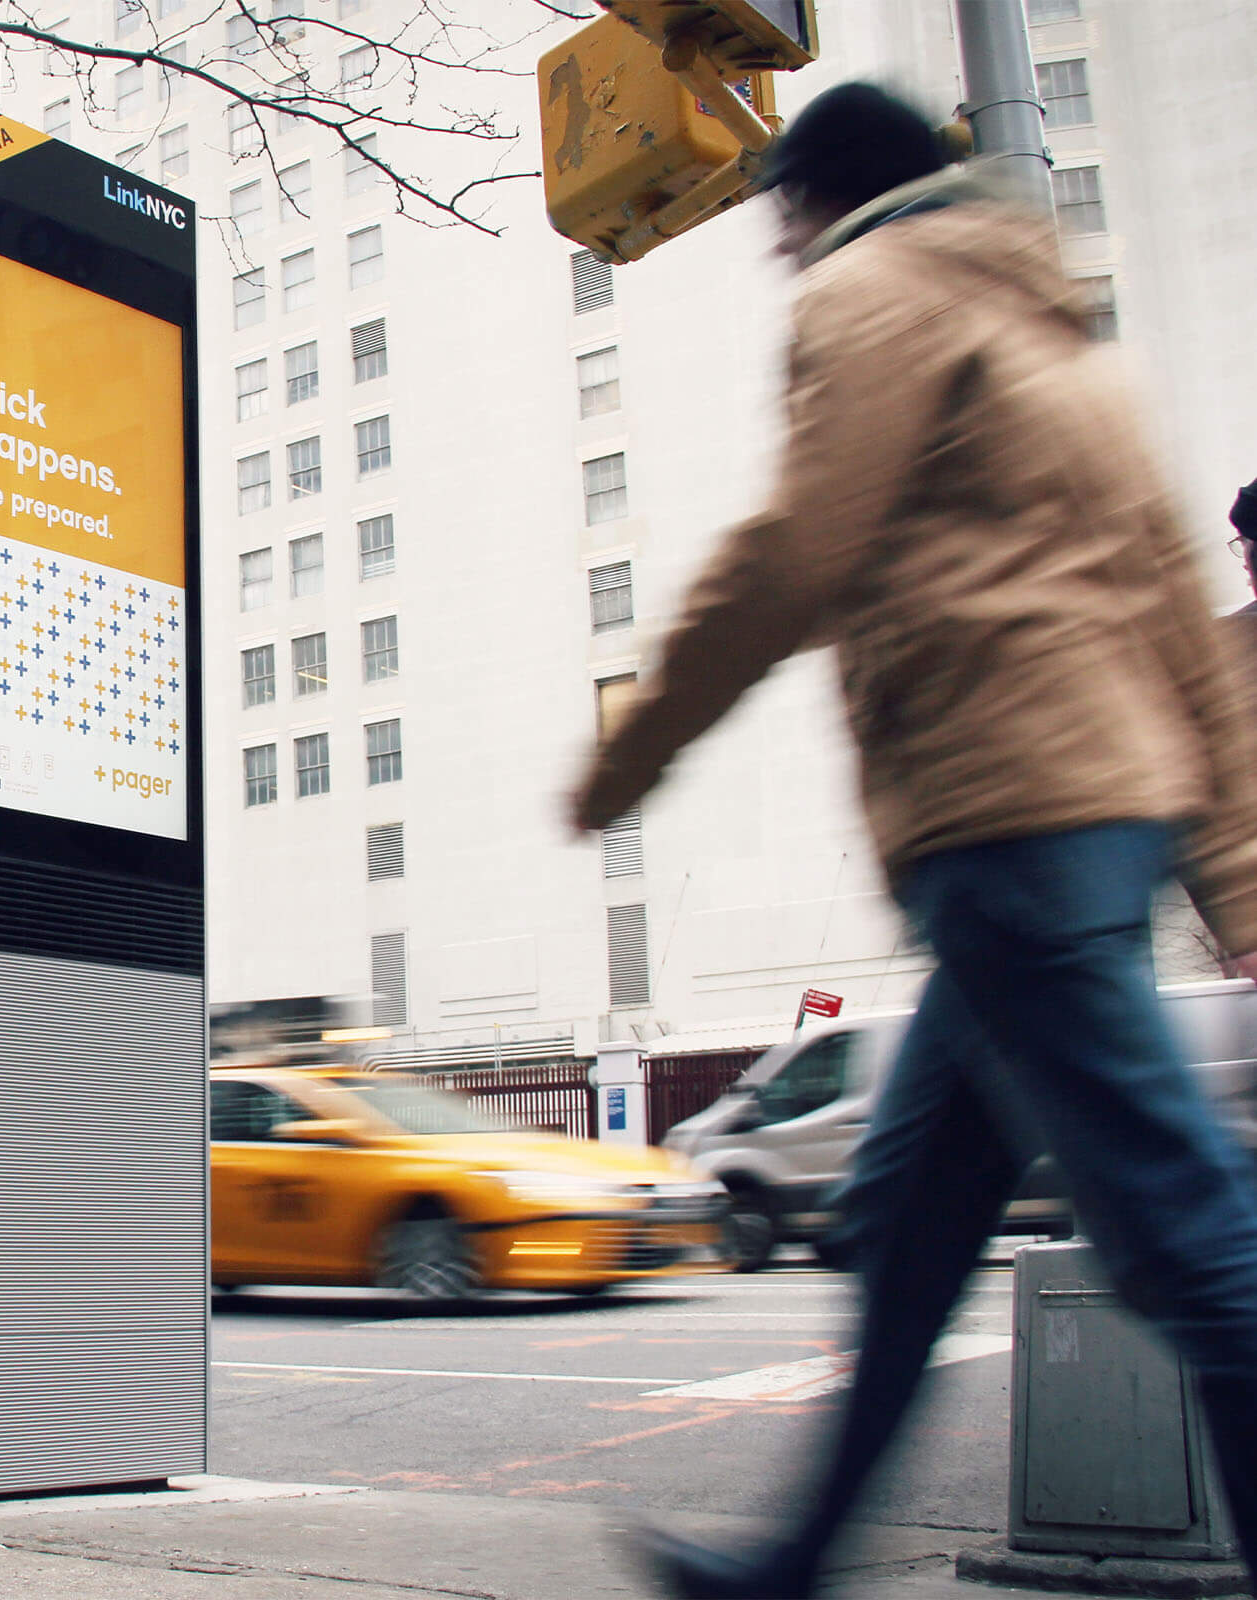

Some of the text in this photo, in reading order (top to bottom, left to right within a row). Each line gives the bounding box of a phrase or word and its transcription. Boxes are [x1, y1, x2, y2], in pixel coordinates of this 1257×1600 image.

[104, 175, 186, 230] LinkNYC
[11, 492, 114, 539] prepared.
[112, 767, 173, 799] pager
